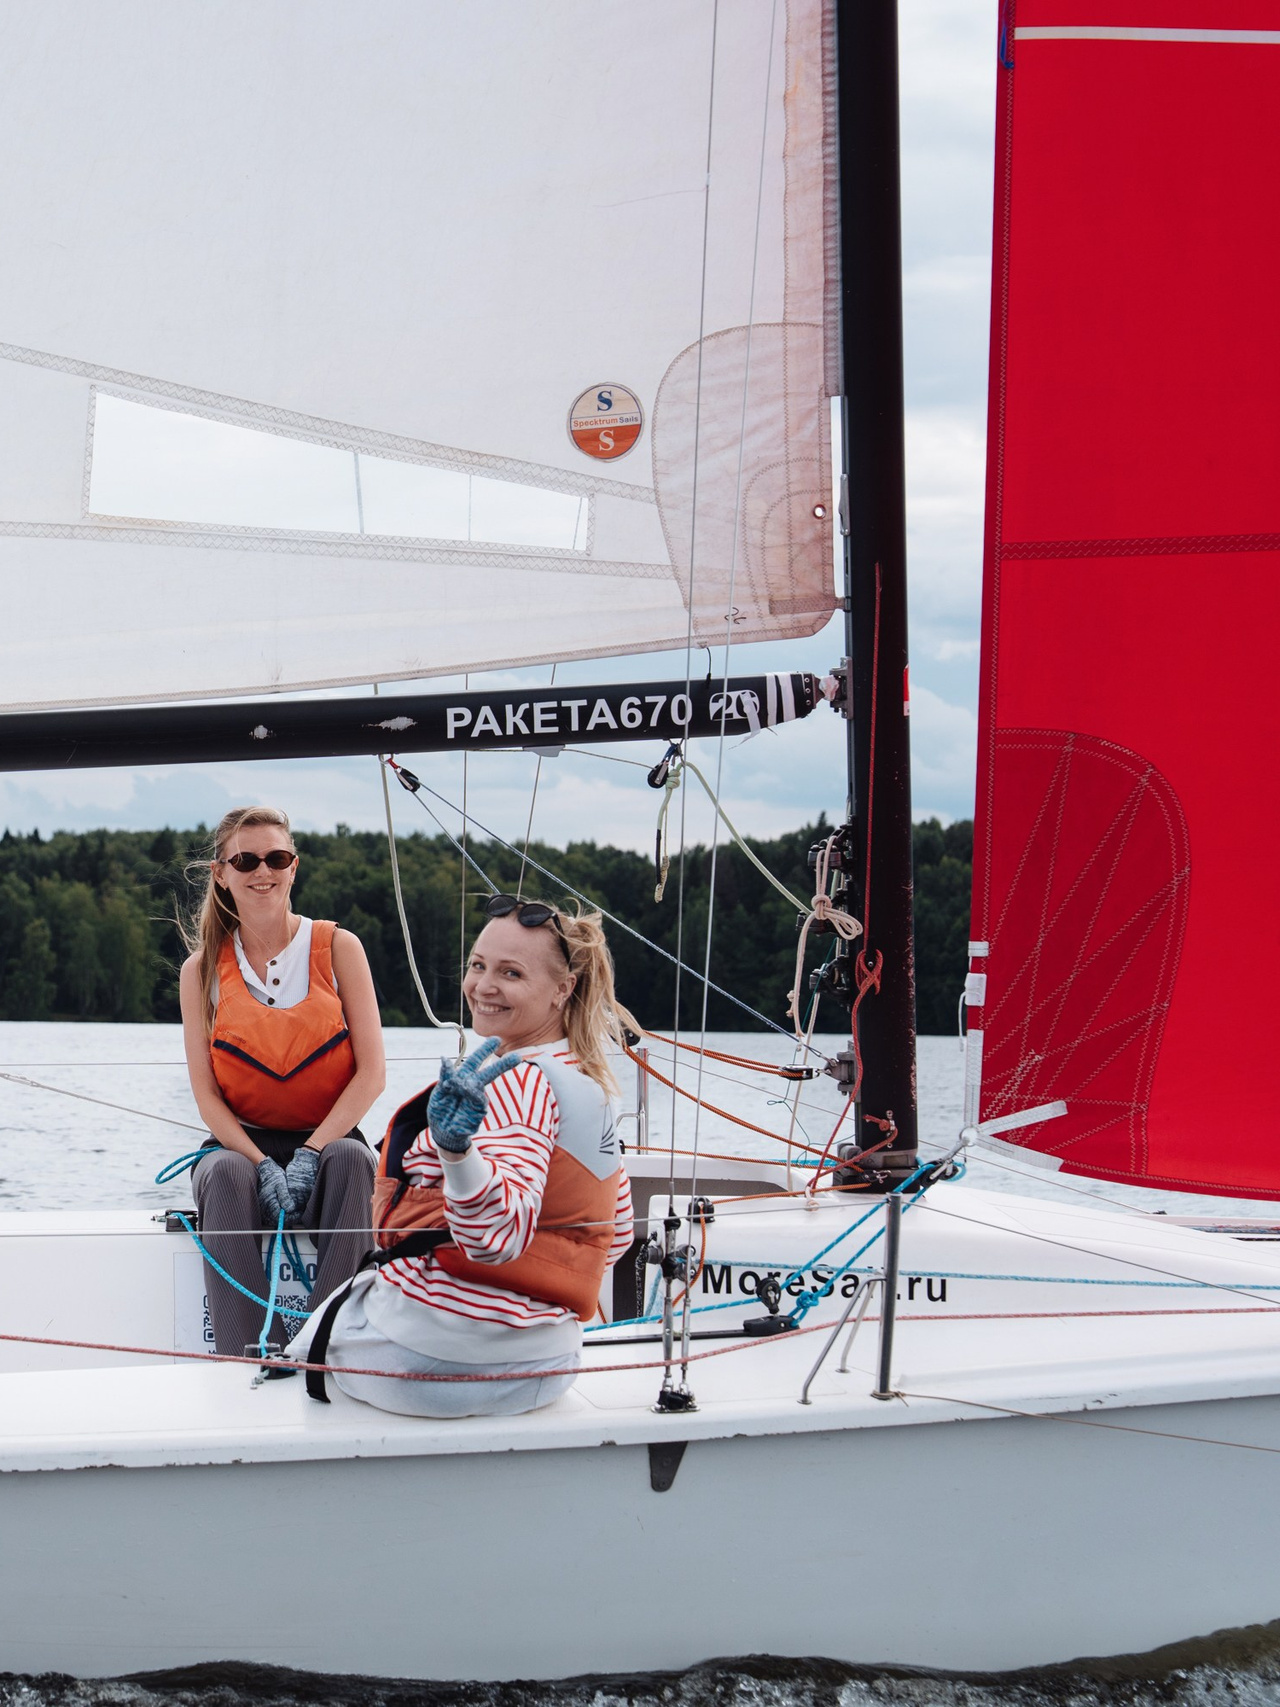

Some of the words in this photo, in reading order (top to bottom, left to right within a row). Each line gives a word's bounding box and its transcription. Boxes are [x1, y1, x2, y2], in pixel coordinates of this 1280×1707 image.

[596, 390, 613, 412] S
[573, 416, 618, 429] Specktrum
[618, 415, 639, 425] Sails
[598, 429, 615, 451] S
